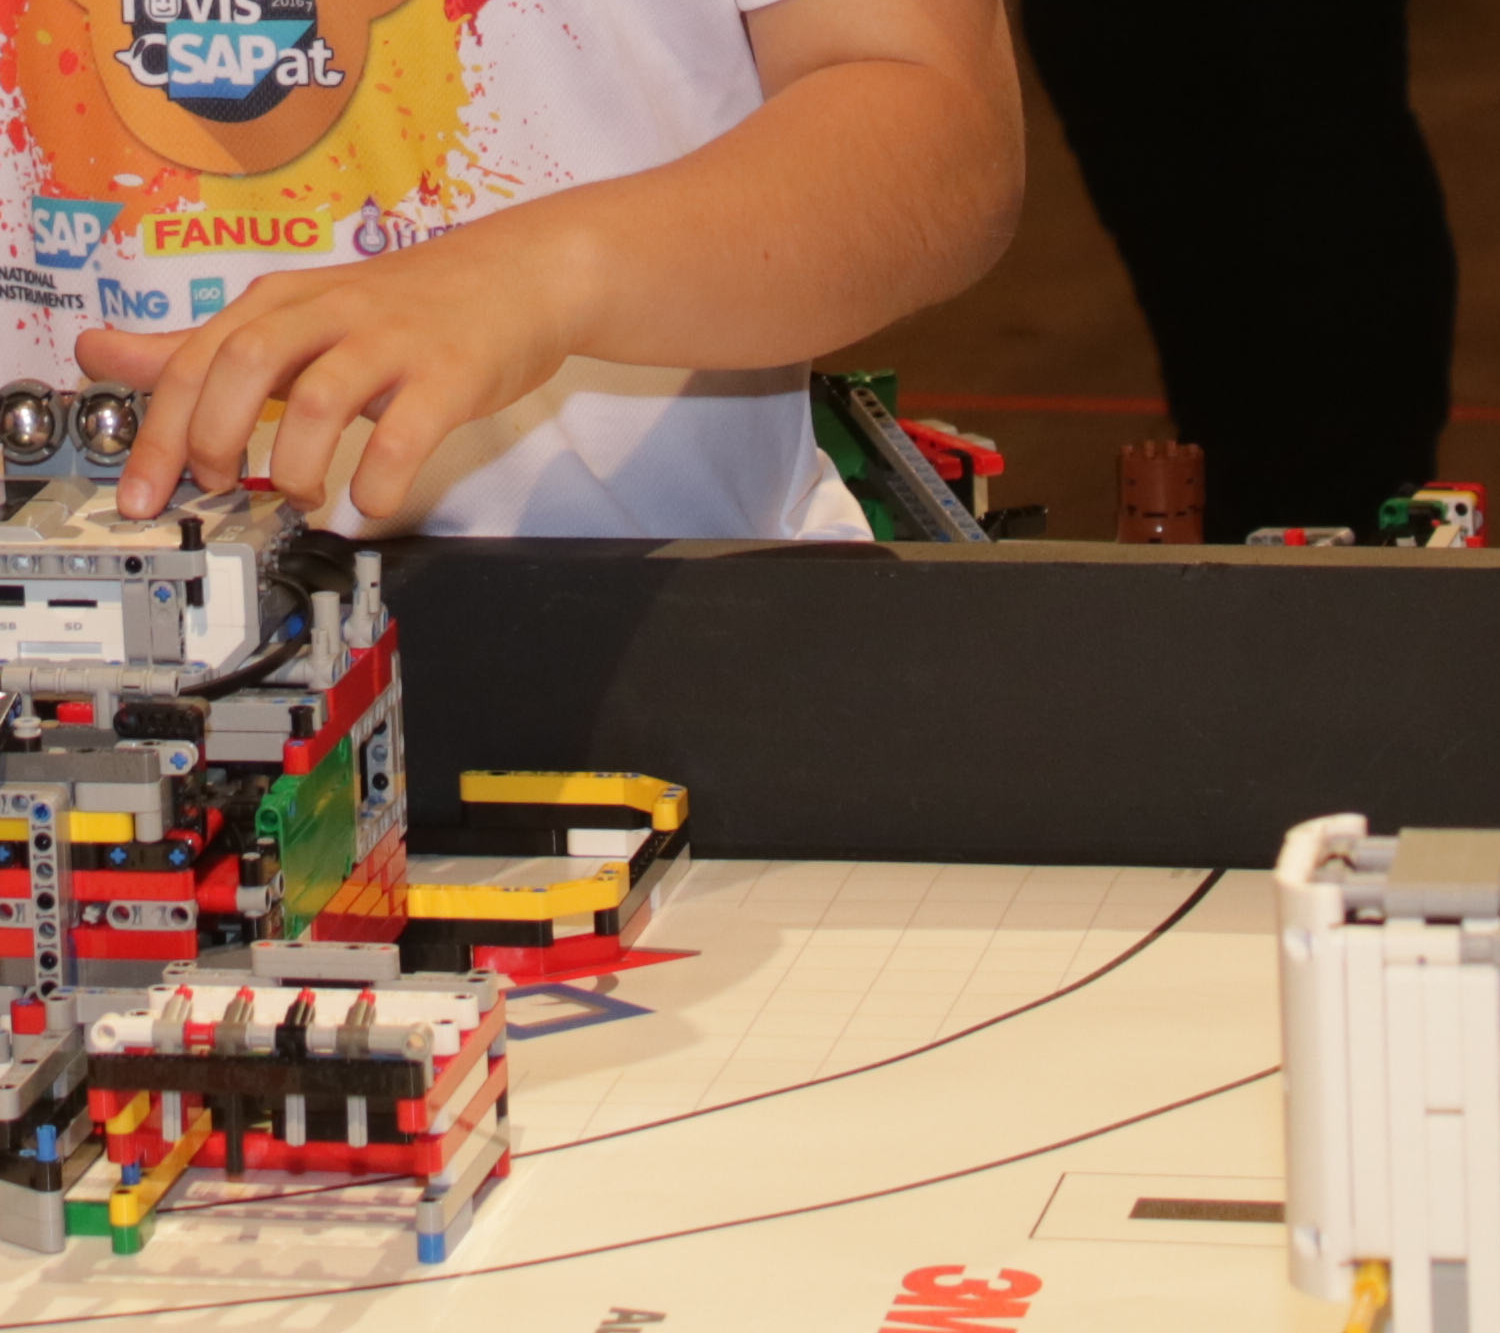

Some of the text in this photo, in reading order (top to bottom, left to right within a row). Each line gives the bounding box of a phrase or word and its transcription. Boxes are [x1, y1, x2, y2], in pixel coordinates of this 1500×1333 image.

[33, 207, 101, 258] SAP
[153, 215, 321, 251] FANUC
[64, 622, 83, 631] SD
